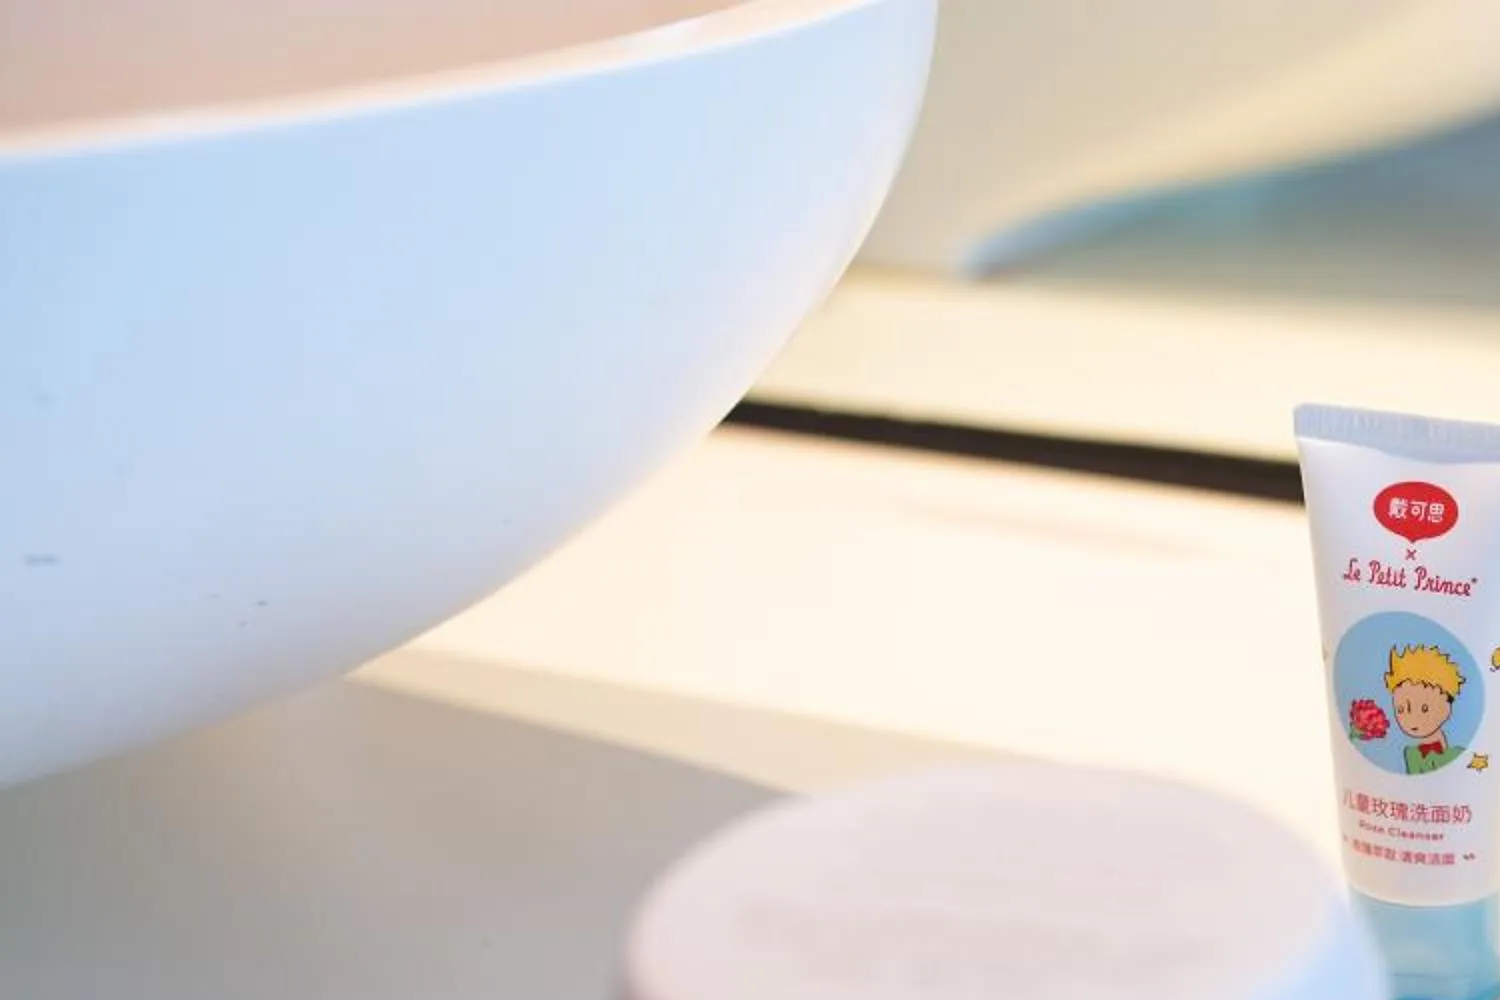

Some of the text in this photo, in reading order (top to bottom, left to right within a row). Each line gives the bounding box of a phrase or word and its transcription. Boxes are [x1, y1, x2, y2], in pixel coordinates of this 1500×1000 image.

[1387, 496, 1446, 524] 戴可思
[1343, 557, 1473, 597] Le Petit Prince
[1342, 789, 1473, 824] 儿童玫瑰洗面奶
[1388, 826, 1445, 841] Cleanser
